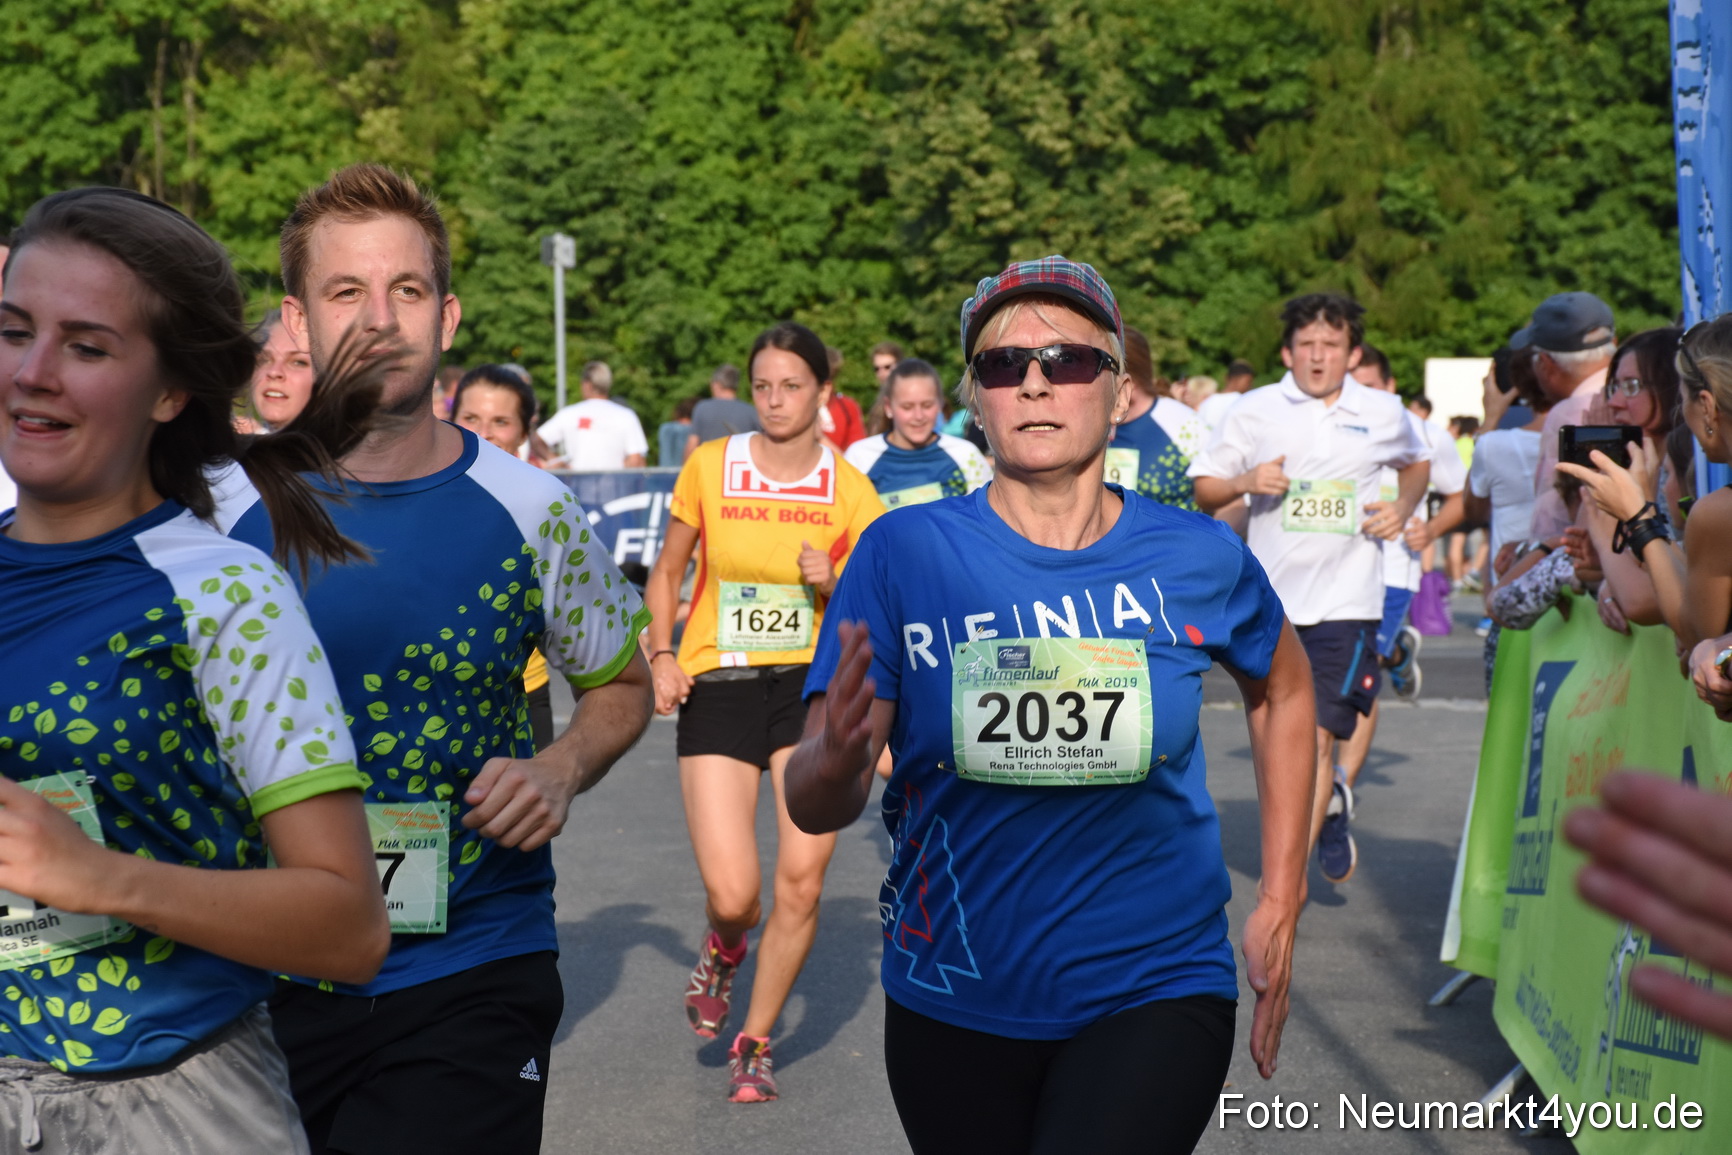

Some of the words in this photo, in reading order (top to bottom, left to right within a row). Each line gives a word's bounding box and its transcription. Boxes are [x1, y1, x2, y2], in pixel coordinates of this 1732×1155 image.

[1110, 467, 1120, 483] 9
[1292, 498, 1346, 518] 2388
[720, 506, 770, 522] MAX
[778, 506, 833, 526] BÖGL
[731, 608, 801, 632] 1624
[983, 666, 1060, 681] firmenlauf
[1077, 677, 1100, 689] run
[1105, 677, 1138, 688] 2019
[977, 691, 1125, 743] 2037
[1005, 746, 1052, 759] Ellrich
[1057, 746, 1103, 758] Stefan
[990, 762, 1014, 770] Rena
[1018, 760, 1085, 772] Technologies
[1087, 760, 1117, 770] GmbH
[377, 838, 400, 849] run
[404, 838, 437, 850] 2019
[374, 852, 406, 896] 7
[386, 901, 404, 911] an
[21, 935, 39, 948] SE
[519, 1071, 540, 1082] adidas
